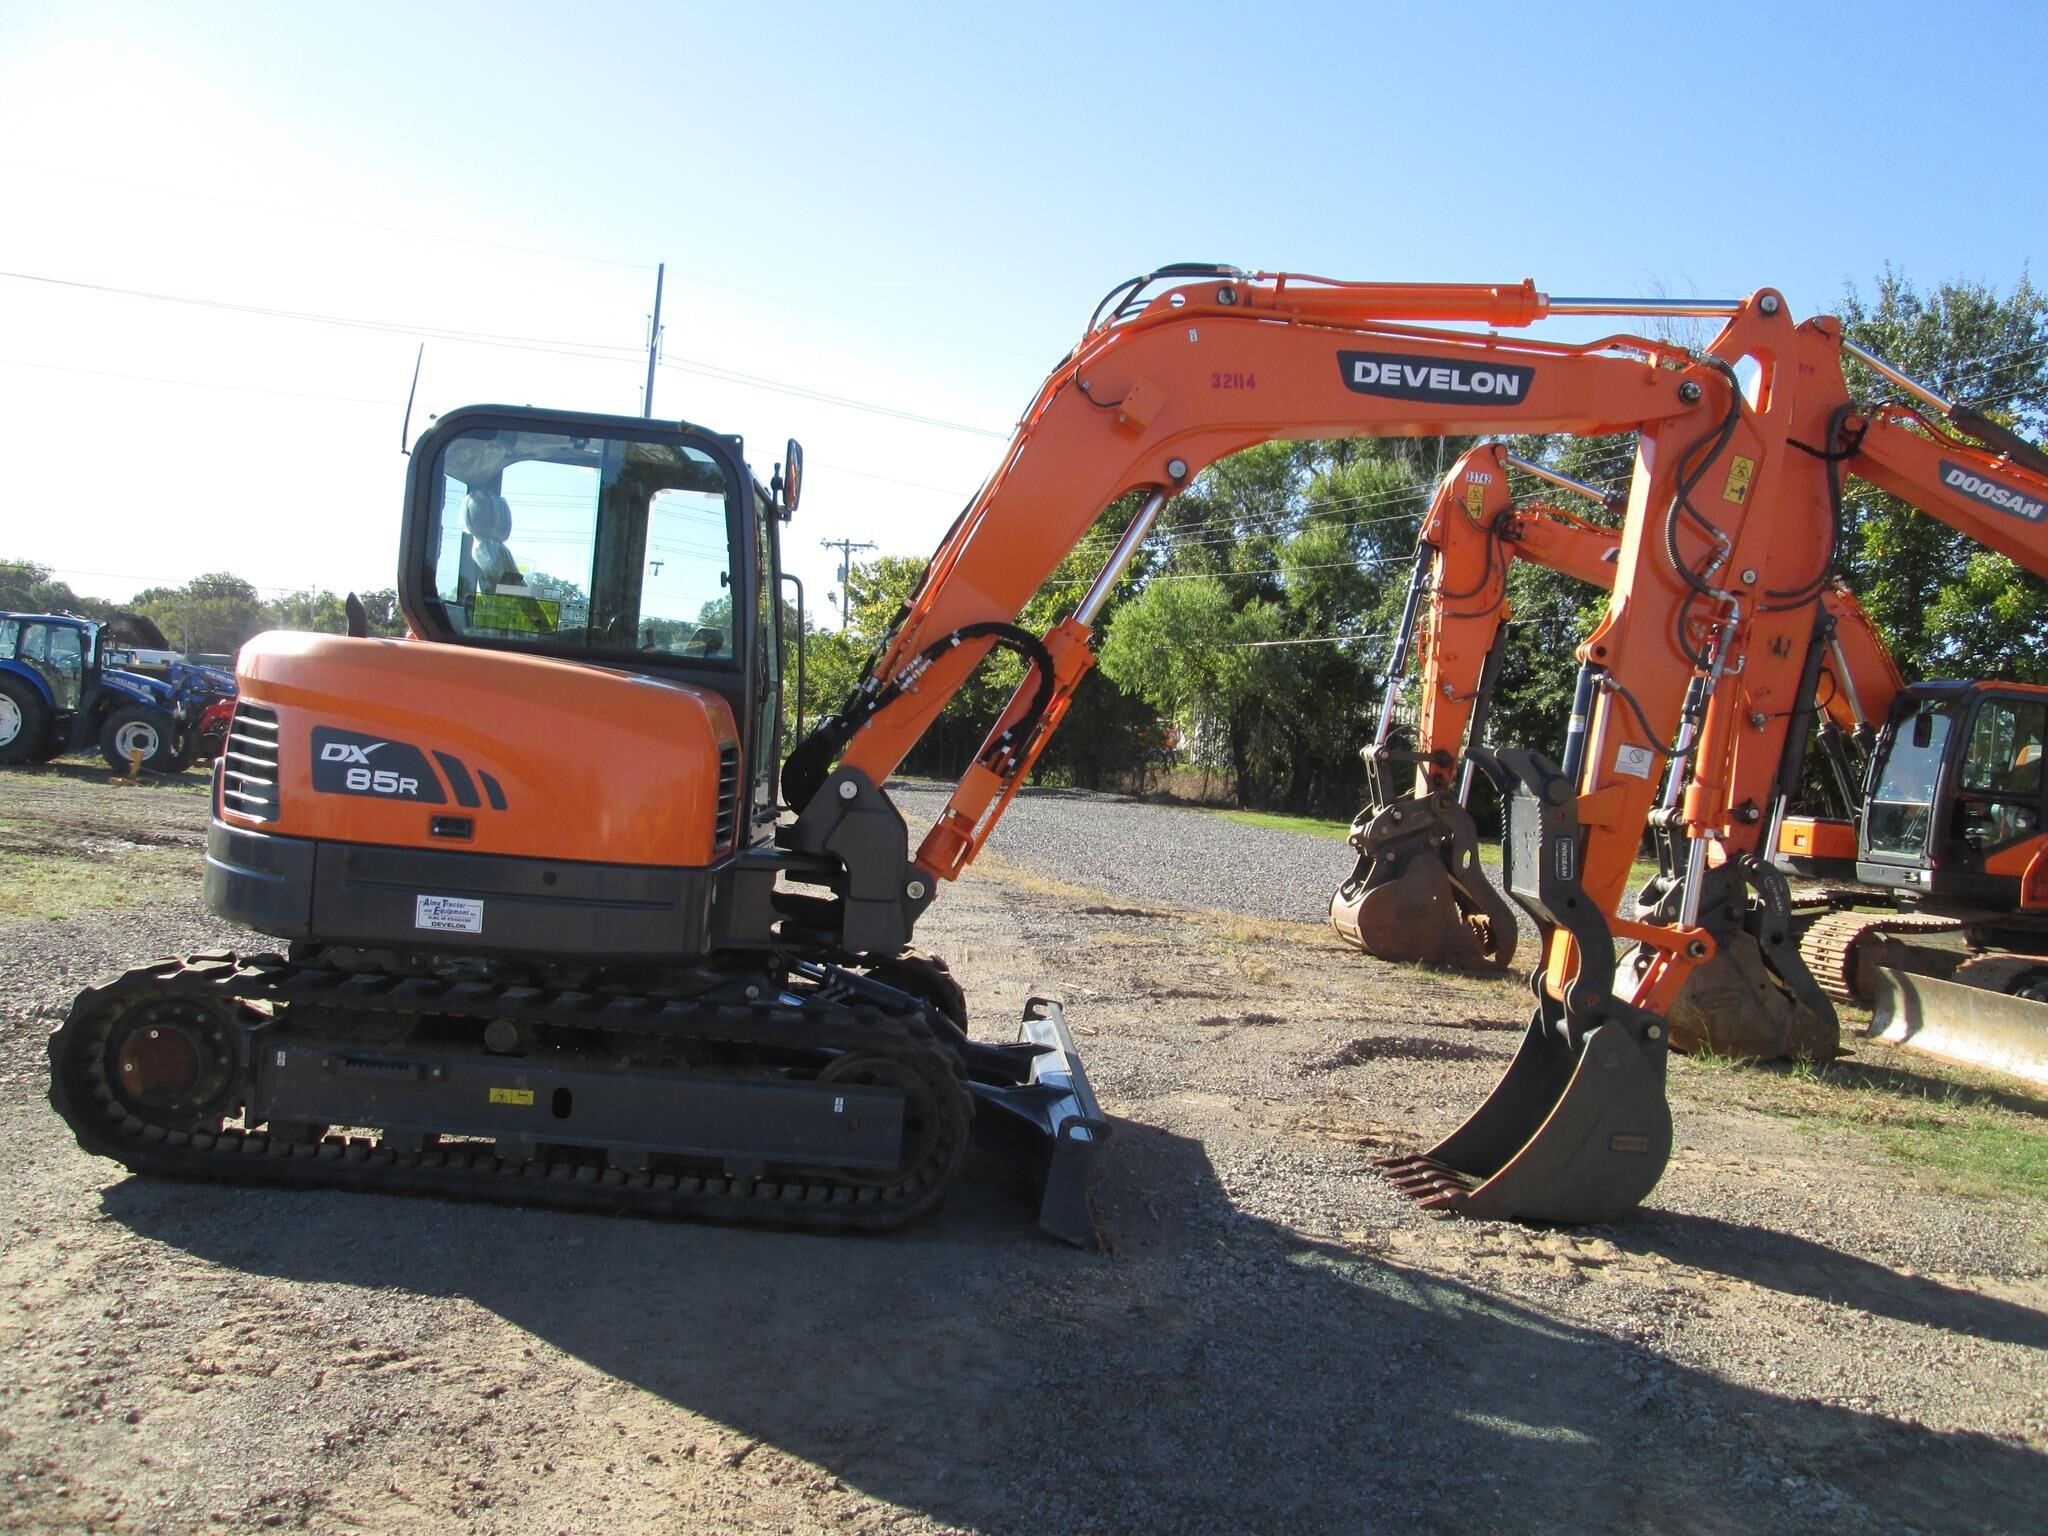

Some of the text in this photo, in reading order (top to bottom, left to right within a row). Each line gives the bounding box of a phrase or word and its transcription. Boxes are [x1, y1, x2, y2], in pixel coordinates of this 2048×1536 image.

[1211, 372, 1257, 390] 32114
[1353, 360, 1520, 397] DEVELON
[1944, 468, 2044, 519] DOOSAN
[320, 742, 389, 765] DX
[346, 767, 419, 795] 85R
[434, 907, 469, 916] Equipment
[442, 899, 466, 907] Tractor
[431, 921, 466, 929] DEVELON
